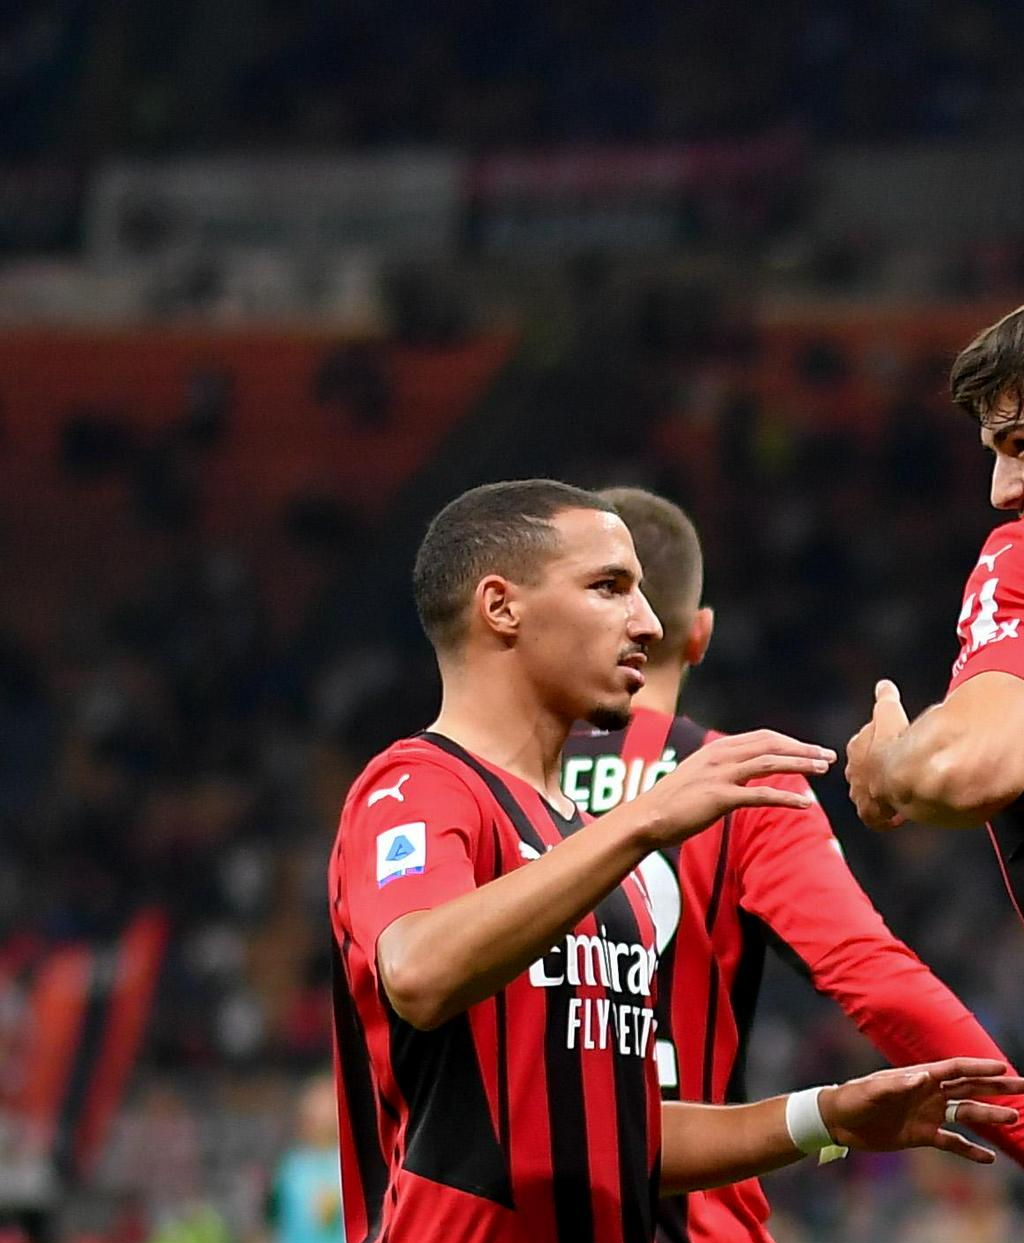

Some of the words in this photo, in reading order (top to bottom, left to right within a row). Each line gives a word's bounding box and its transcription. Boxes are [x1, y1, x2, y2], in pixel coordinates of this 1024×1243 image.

[563, 746, 678, 813] EBIĆ
[528, 924, 659, 997] Emira
[567, 998, 611, 1050] FLY
